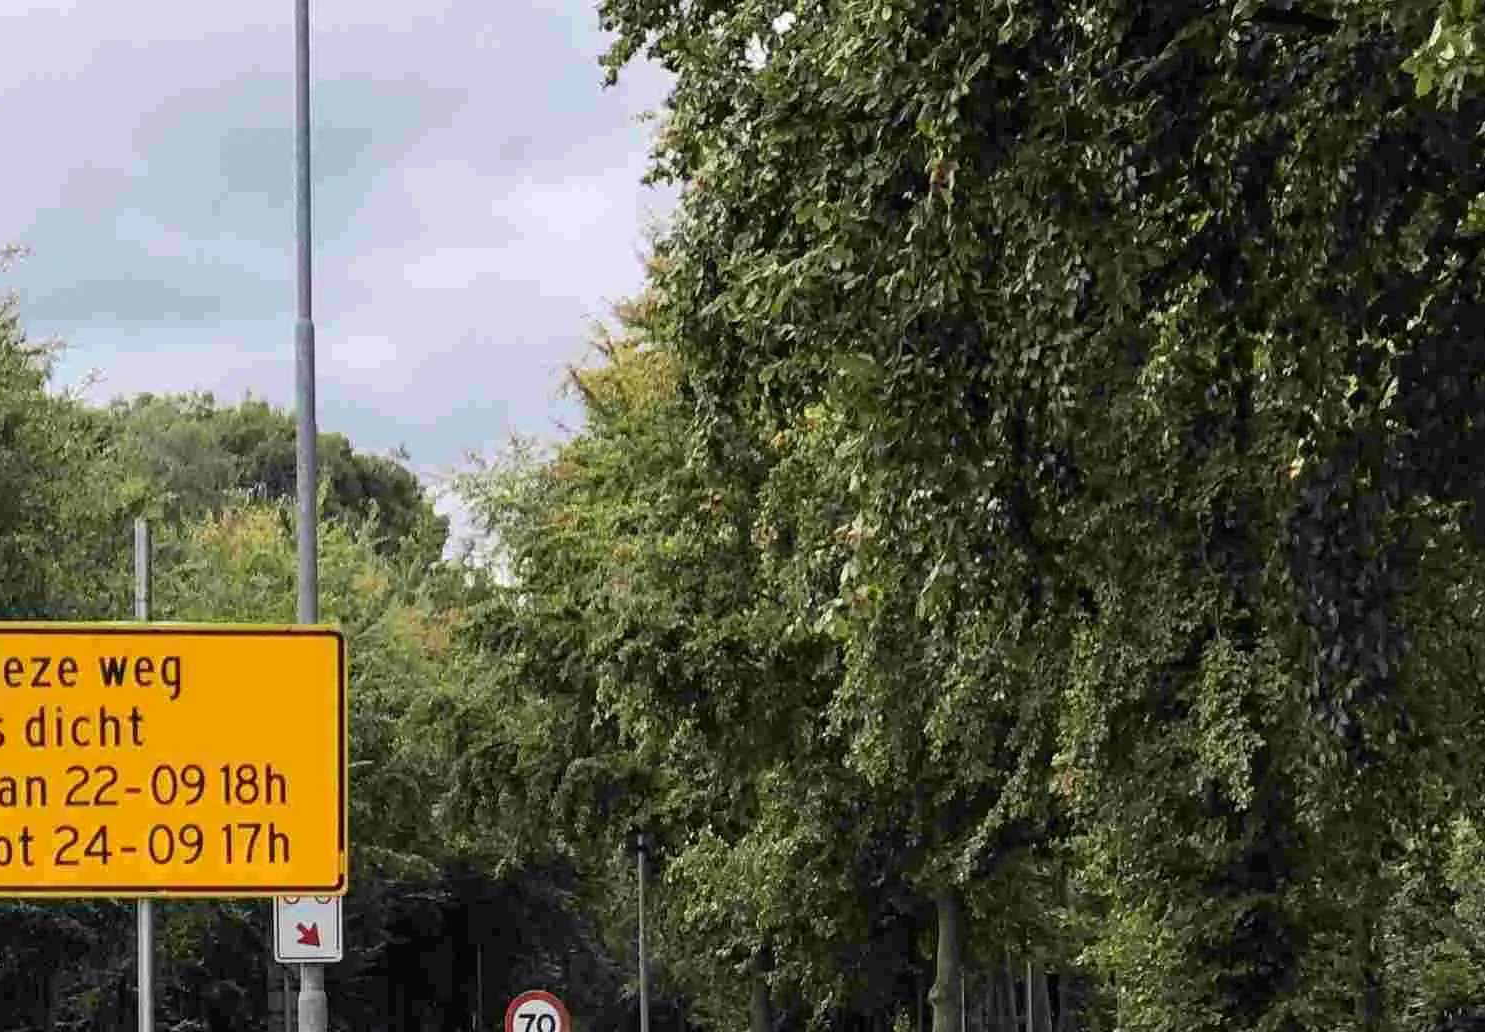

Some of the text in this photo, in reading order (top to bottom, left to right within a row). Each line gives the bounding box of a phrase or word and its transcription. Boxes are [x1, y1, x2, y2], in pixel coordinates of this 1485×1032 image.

[99, 655, 182, 702] weg
[24, 706, 146, 749] dicht
[64, 764, 206, 807] 22-09
[220, 763, 287, 806] 18h
[53, 823, 204, 867] 24-09
[221, 822, 290, 865] 17h
